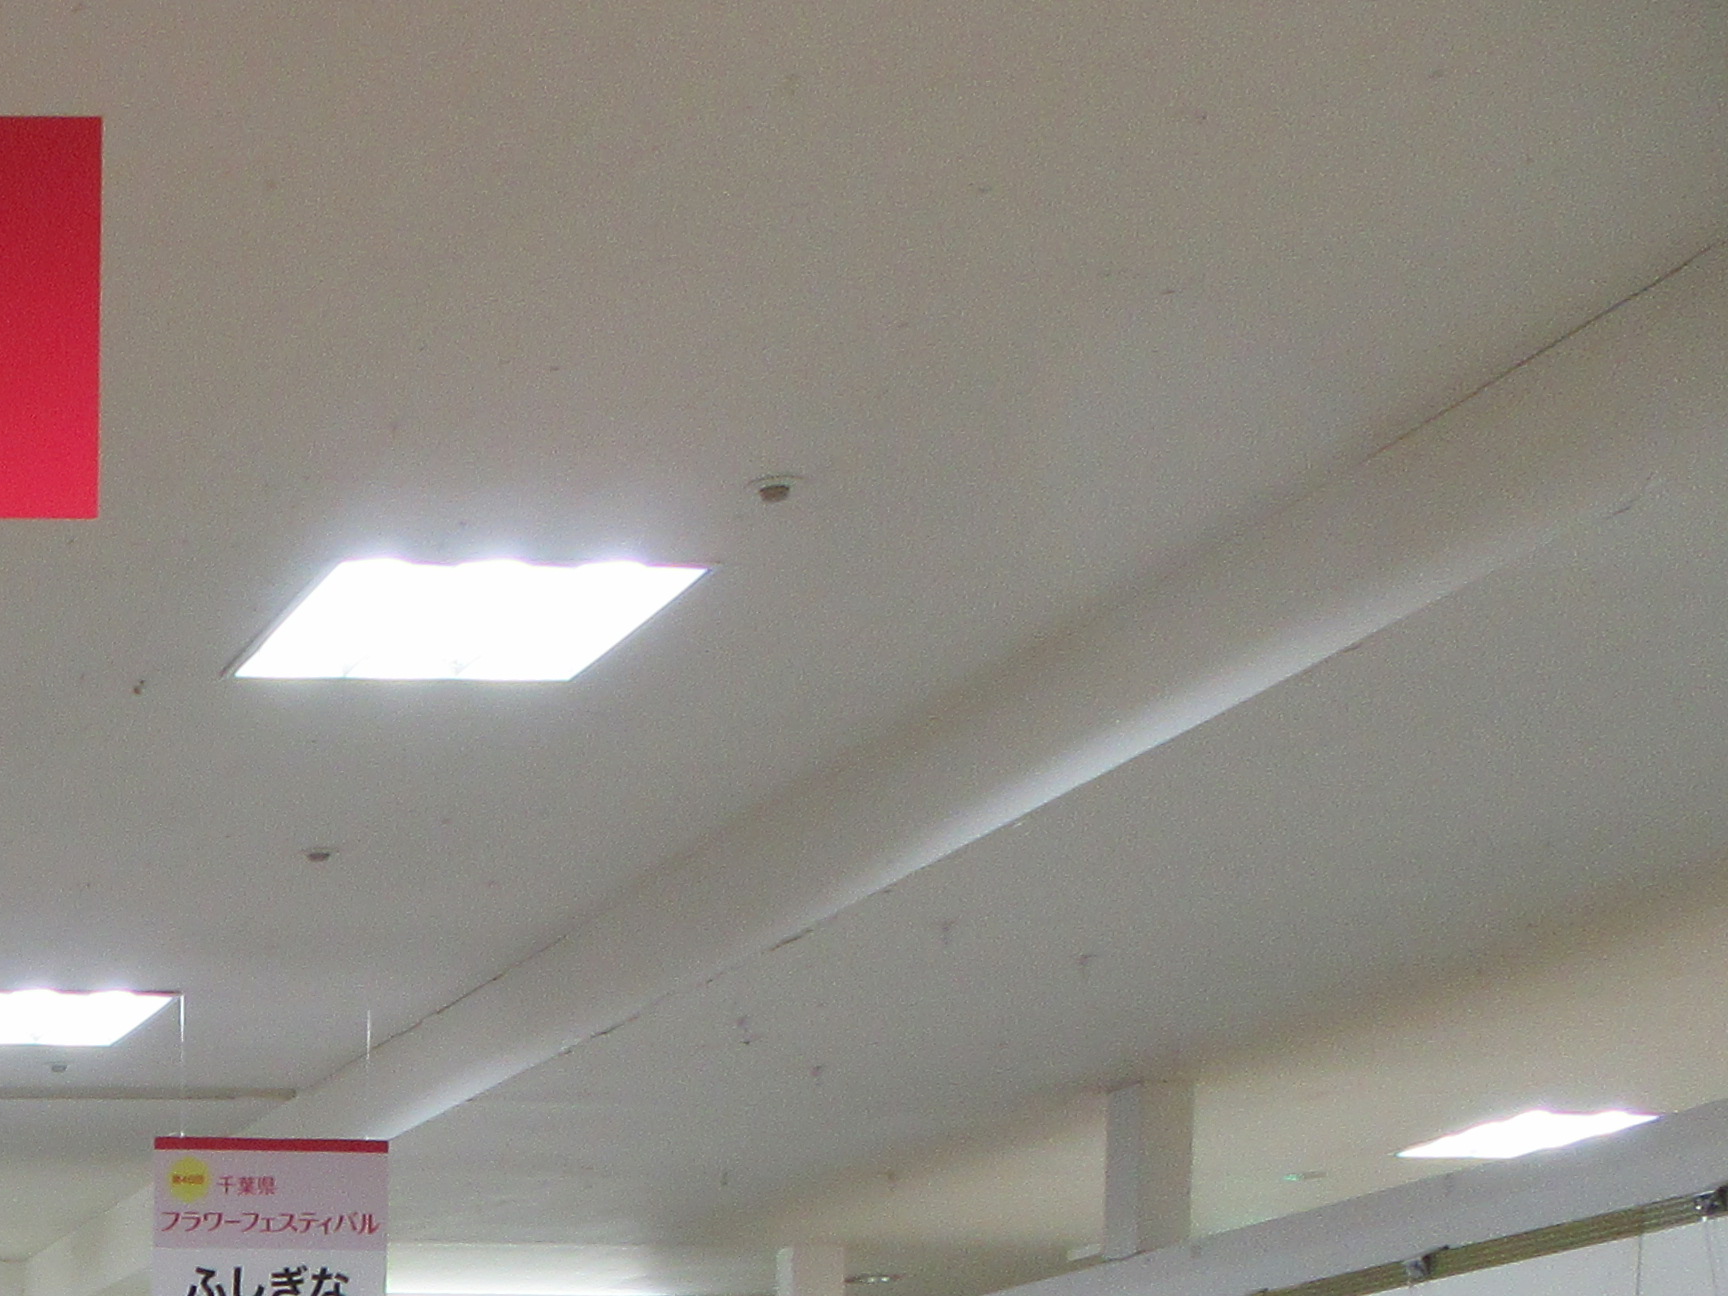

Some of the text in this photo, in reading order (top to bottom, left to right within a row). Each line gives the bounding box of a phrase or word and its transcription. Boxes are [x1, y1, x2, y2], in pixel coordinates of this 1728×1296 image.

[217, 1175, 278, 1196] 千葉県
[161, 1211, 380, 1235] フラワーフェスティバル
